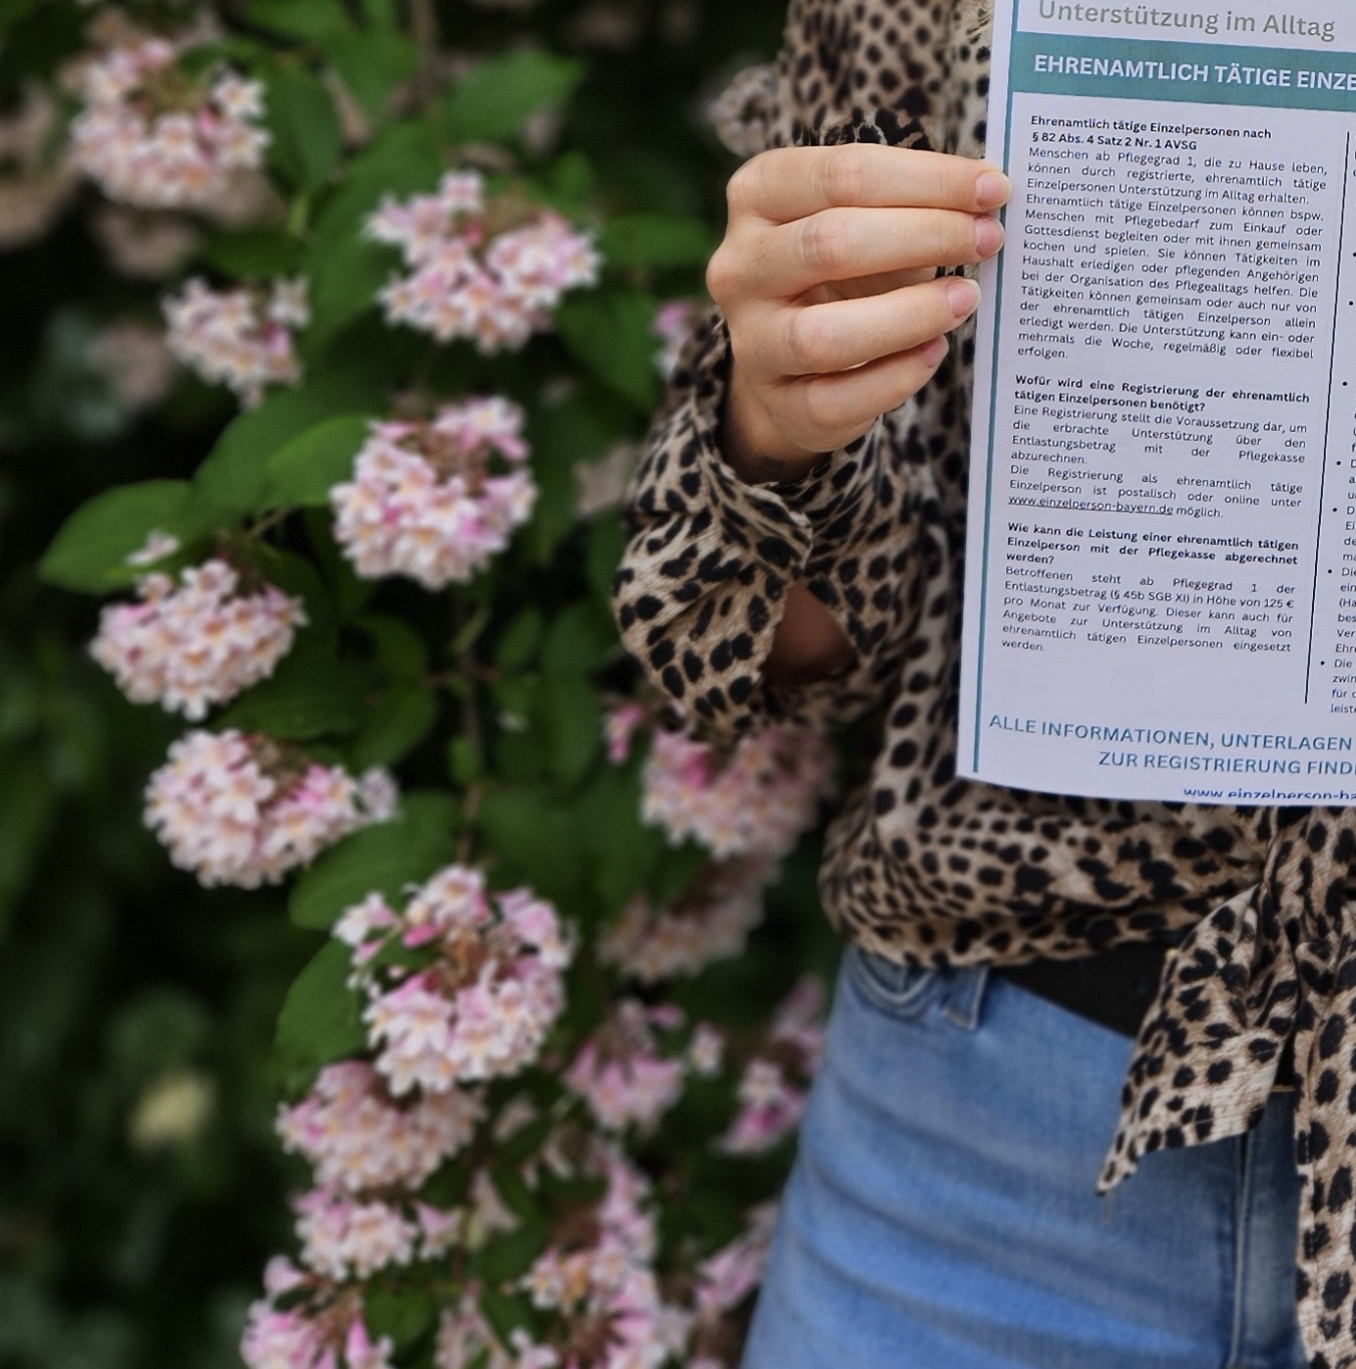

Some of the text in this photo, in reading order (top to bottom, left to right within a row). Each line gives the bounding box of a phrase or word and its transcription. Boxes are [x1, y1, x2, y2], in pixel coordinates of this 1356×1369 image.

[1039, 0, 1335, 42] Unterstützung im Alltag
[1034, 54, 1208, 81] EHRENAMTLICH
[1214, 63, 1291, 86] TÄTIGE
[1031, 115, 1271, 138] Ehrenamtlich tätige Einzelpersonen nach
[1041, 132, 1055, 141] 82
[1058, 133, 1083, 143] Abs.
[1086, 135, 1094, 144] 4
[1097, 135, 1122, 145] Satz
[1124, 136, 1131, 146] 2
[1134, 137, 1152, 147] Nr.
[1155, 138, 1161, 148] 1
[1164, 139, 1196, 150] AVSG
[1029, 147, 1327, 175] Menschen ab Pflegegrad 1, die zu Hause leben,
[1027, 177, 1308, 204] Einzelpersonen Unterstützung im Alltag erhalten.
[1028, 162, 1326, 192] können durch registrierte, ehrenamtlich tätige
[1026, 193, 1323, 222] Ehrenamtlich tätige Einzelpersonen können bspw.
[1025, 208, 1323, 236] Menschen mit Pflegebedarf zum Einkauf oder
[1014, 390, 1205, 413] tätigen Einzelpersonen benötigt?
[1015, 374, 1309, 402] Wofür wird eine Registrierung der ehrenamtlich
[1008, 496, 1223, 518] www.einzelperson-bayern.de möglich.
[1007, 536, 1297, 564] Einzelperson mit der Pflegekasse abgerechnet
[1008, 522, 1298, 551] Wie kann die Leistung einer ehrenamtlich tätigen
[1006, 553, 1054, 564] werden?
[1002, 624, 1290, 652] ehrenamtlich tätigen Einzelpersonen eingesetzt
[989, 714, 1035, 733] ALLE
[1042, 721, 1214, 749] INFORMATIONEN,
[1221, 733, 1351, 750] UNTERLAGEN
[1098, 751, 1137, 767] ZUR
[1144, 754, 1300, 773] REGISTRIERUNG
